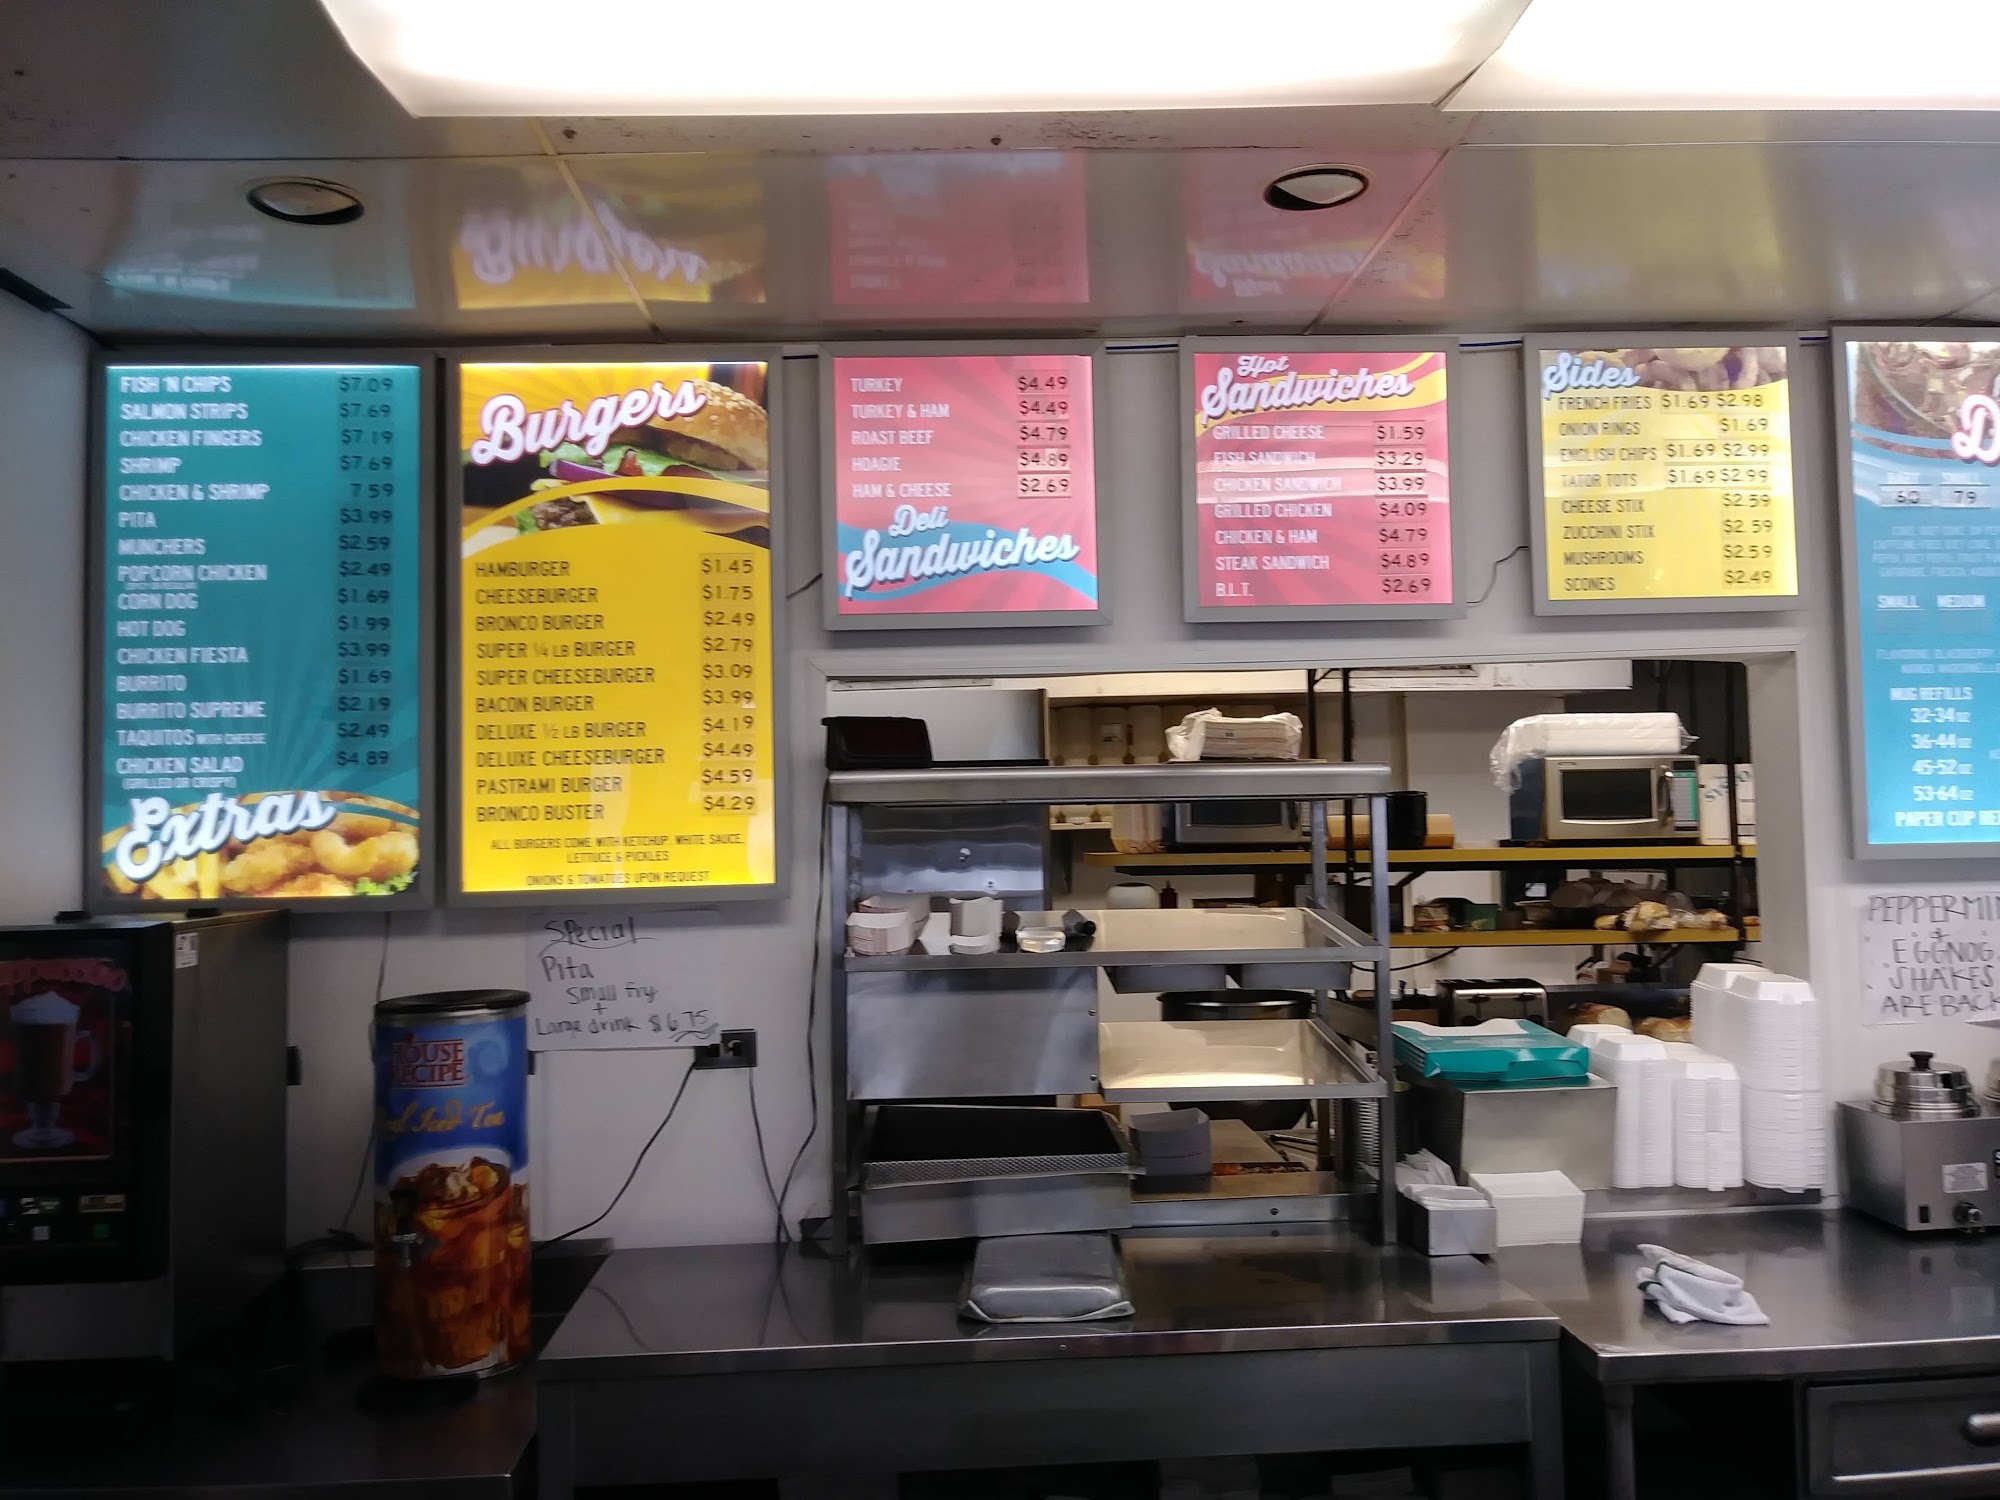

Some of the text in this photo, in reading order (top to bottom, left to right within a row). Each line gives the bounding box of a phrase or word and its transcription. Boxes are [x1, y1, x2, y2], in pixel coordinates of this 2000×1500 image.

[1237, 355, 1290, 378] Hot
[1543, 351, 1640, 400] Sides
[121, 376, 160, 393] FISH
[182, 376, 231, 393] CHIPS
[850, 378, 903, 392] TURKEY
[1017, 376, 1068, 393] $4.49
[1202, 368, 1414, 427] Sandwiches
[1558, 396, 1652, 410] FRENCH FRIES
[1662, 393, 1763, 408] $1.69 $2.98
[121, 403, 248, 419] SALMON STRIPS
[851, 404, 949, 418] TURKEY & HAM
[1019, 400, 1068, 416] $4.49
[471, 380, 708, 465] Burgers
[1559, 422, 1640, 435] ONION RINGS
[1721, 418, 1768, 432] $1.69
[120, 430, 262, 447] CHICKEN FINGERS
[851, 430, 934, 444] ROAST BEEF
[1019, 425, 1068, 441] $4.79
[1213, 425, 1325, 440] GRILLED CHEESE
[1376, 425, 1425, 440] $1.59
[1214, 452, 1316, 465] FISH SANDWICH
[1376, 451, 1424, 466] $3.29
[1560, 447, 1657, 461] ENGLISH CHIPS
[1666, 443, 1769, 458] $1.69 $2.99
[852, 457, 901, 471] HOAGIE
[1019, 451, 1068, 467] $4.89
[1377, 477, 1424, 491] $3.99
[1561, 473, 1637, 487] TATOR TOTS
[1668, 468, 1768, 484] $1.69 $2.99
[119, 484, 189, 501] CHICKEN
[853, 483, 952, 497] HAM & CHEESE
[1020, 478, 1069, 493] $2.69
[1214, 477, 1341, 492] CHICKEN SANDWICH
[1562, 499, 1645, 514] CHEESE STIX
[1722, 494, 1771, 507] $2.59
[1214, 504, 1332, 518] GRILLED CHICKEN
[1378, 502, 1427, 517] $4.09
[118, 512, 157, 528] PITA
[888, 505, 949, 537] Deli
[1722, 519, 1773, 534] $2.59
[1215, 529, 1318, 544] CHICKEN & HAM
[1378, 528, 1427, 543] $4.79
[1563, 525, 1655, 539] ZUCCHINI STIX
[1564, 551, 1644, 565] MUSHROOMS
[1723, 544, 1772, 559] $2.59
[475, 561, 570, 577] HAMBURGER
[701, 559, 754, 575] $1.45
[844, 528, 1080, 601] Sandwiches
[1216, 556, 1330, 570] STEAK SANDWICH
[1380, 553, 1430, 569] $4.89
[197, 565, 267, 581] CHICKEN
[1725, 570, 1772, 585] $2.49
[1216, 583, 1253, 597] B.L.T.
[1381, 578, 1431, 594] $2.69
[1564, 577, 1615, 591] SCONES
[475, 588, 598, 604] CHEESEBURGER
[702, 585, 753, 601] $1.75
[117, 593, 199, 610] CORN DOG
[476, 614, 604, 631] BRONCO BURGER
[703, 611, 755, 628] $2.49
[117, 620, 187, 637] HOT DOG
[477, 642, 528, 659] SUPER
[553, 644, 569, 657] LB
[574, 641, 635, 657] BURGER
[702, 637, 754, 654] $2.79
[117, 647, 249, 664] CHICKEN FIESTA
[477, 667, 656, 686] SUPER CHEESEBURGER
[702, 663, 753, 681] $3.09
[116, 675, 187, 692] BURRITO
[702, 689, 754, 706] $3.99
[1919, 686, 1974, 700] REFILLS
[116, 701, 267, 719] BURRITO SUPREME
[476, 696, 594, 713] BACON BURGER
[476, 724, 537, 740] DELUXE
[563, 726, 580, 739] LB
[585, 721, 647, 738] BURGER
[702, 715, 754, 733] $4.19
[116, 729, 195, 746] TAQUITOS
[476, 749, 665, 767] DELUXE CHEESEBURGER
[703, 741, 754, 759] $4.49
[116, 756, 244, 774] CHICKEN SALAD
[476, 776, 623, 795] PASTRAMI BURGER
[701, 769, 753, 786] $4.59
[703, 795, 755, 812] $4.29
[476, 804, 605, 822] BRONCO BUSTER
[1895, 811, 1976, 826] PAPER CUP
[116, 792, 337, 882] Extras
[513, 838, 561, 849] BURGERS
[541, 956, 594, 982] Pita
[1888, 965, 1995, 991] SHAKES
[592, 1003, 608, 1015] +
[1880, 995, 1933, 1017] ARE
